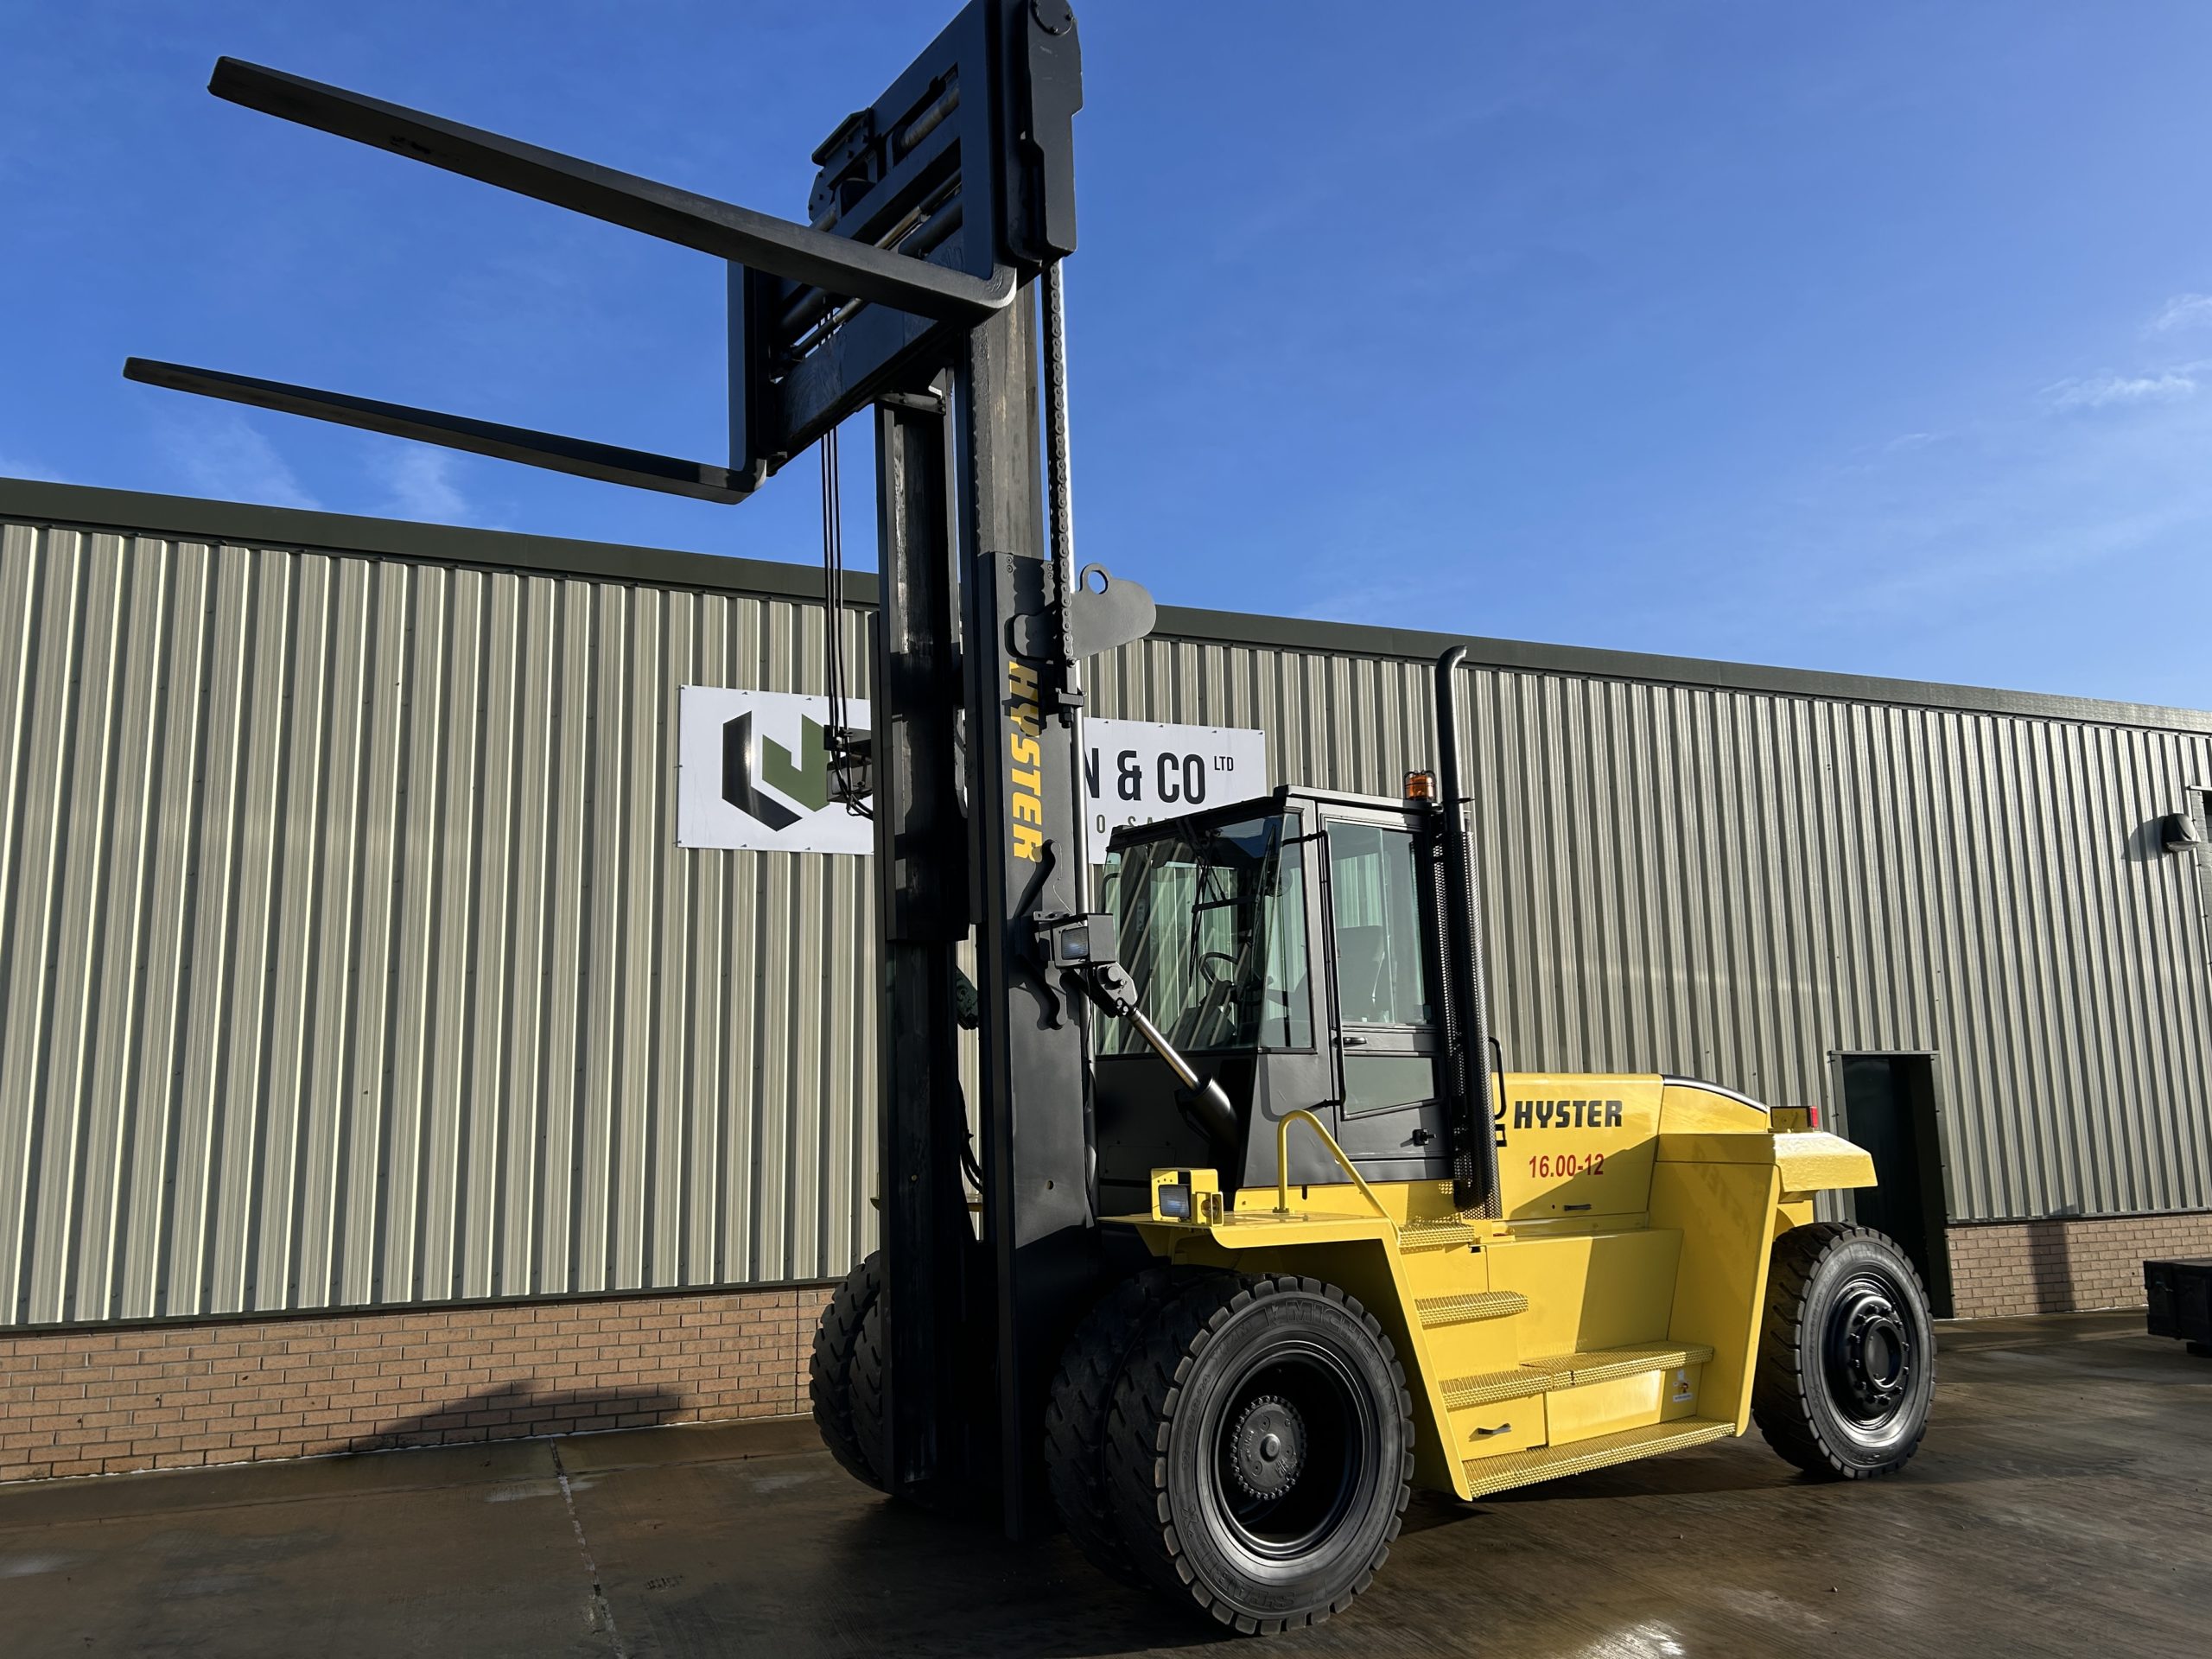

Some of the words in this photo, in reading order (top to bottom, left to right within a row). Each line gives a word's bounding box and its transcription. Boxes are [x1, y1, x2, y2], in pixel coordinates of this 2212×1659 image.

[1007, 660, 1043, 862] HYSTER
[1116, 750, 1142, 801] &
[1156, 752, 1206, 804] CO
[1213, 755, 1234, 772] LTD
[1513, 1100, 1623, 1129] HYSTER
[1529, 1153, 1605, 1178] 16.00-12
[1286, 1300, 1398, 1420] MICHELIN
